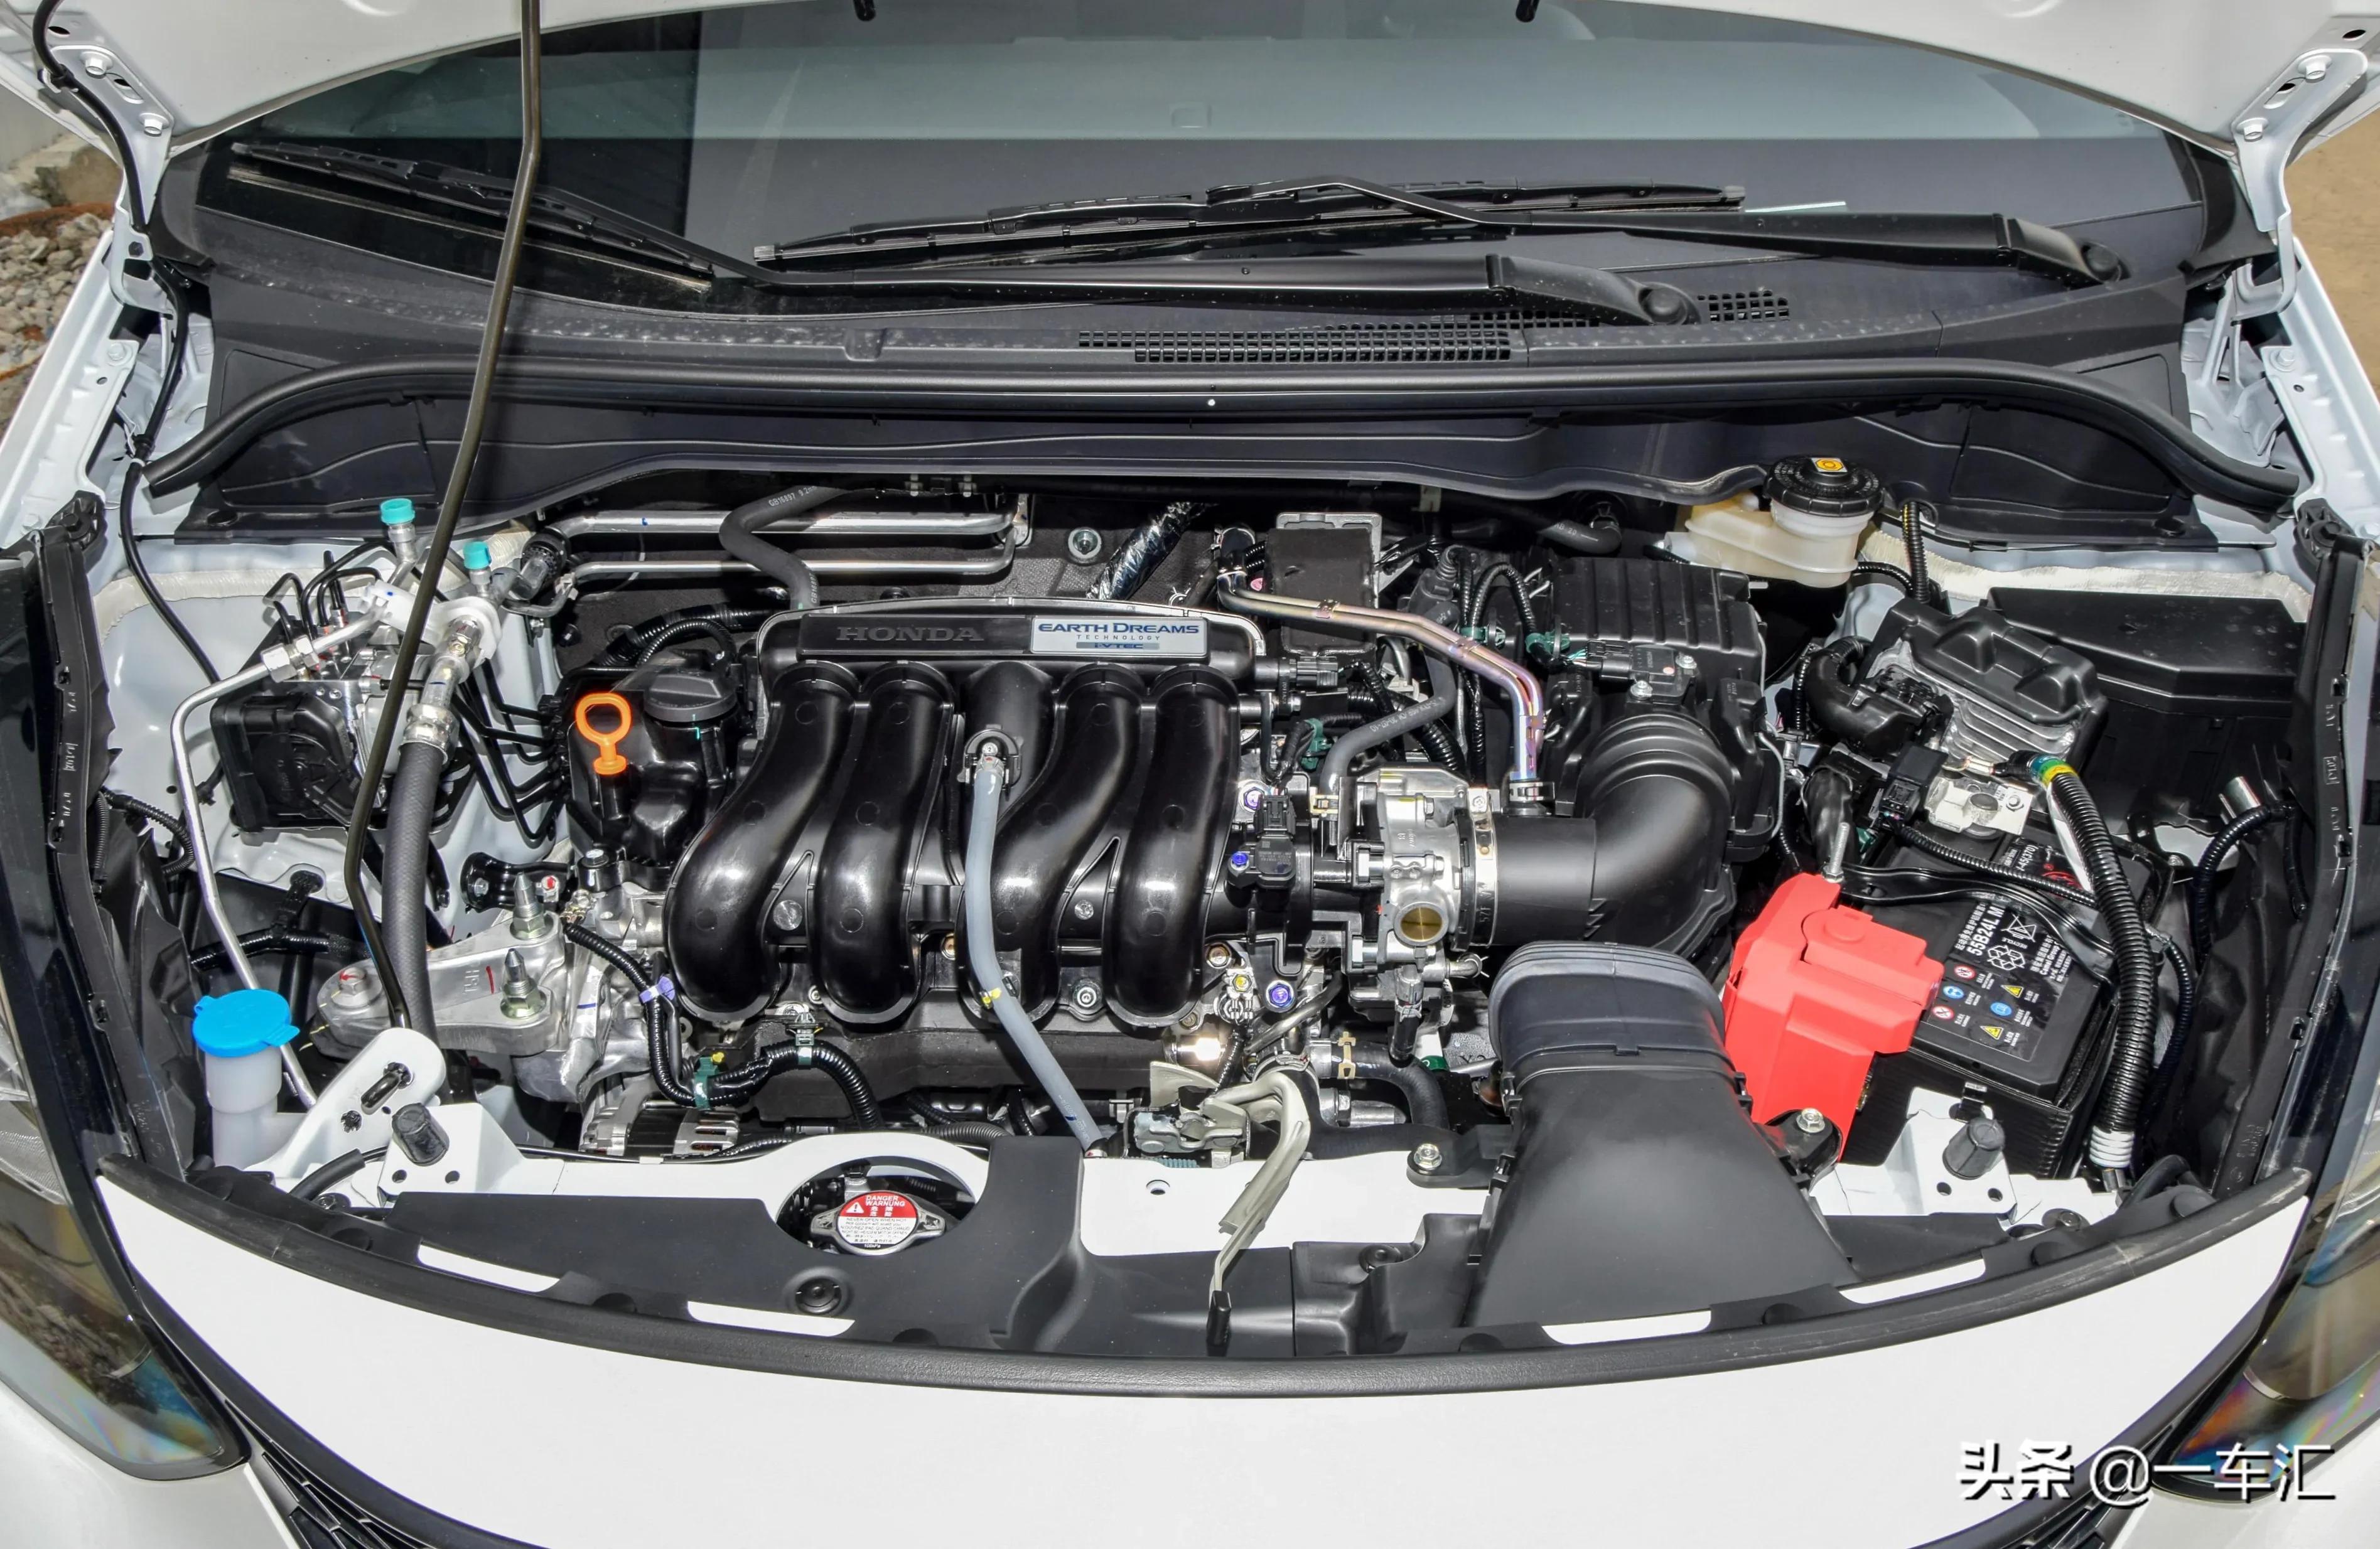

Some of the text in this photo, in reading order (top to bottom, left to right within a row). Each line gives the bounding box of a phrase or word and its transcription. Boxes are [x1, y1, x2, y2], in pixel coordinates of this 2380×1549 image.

[836, 626, 984, 641] HONDA
[1038, 622, 1200, 633] EARTH DREAMS
[1966, 918, 2000, 956] 55B24L
